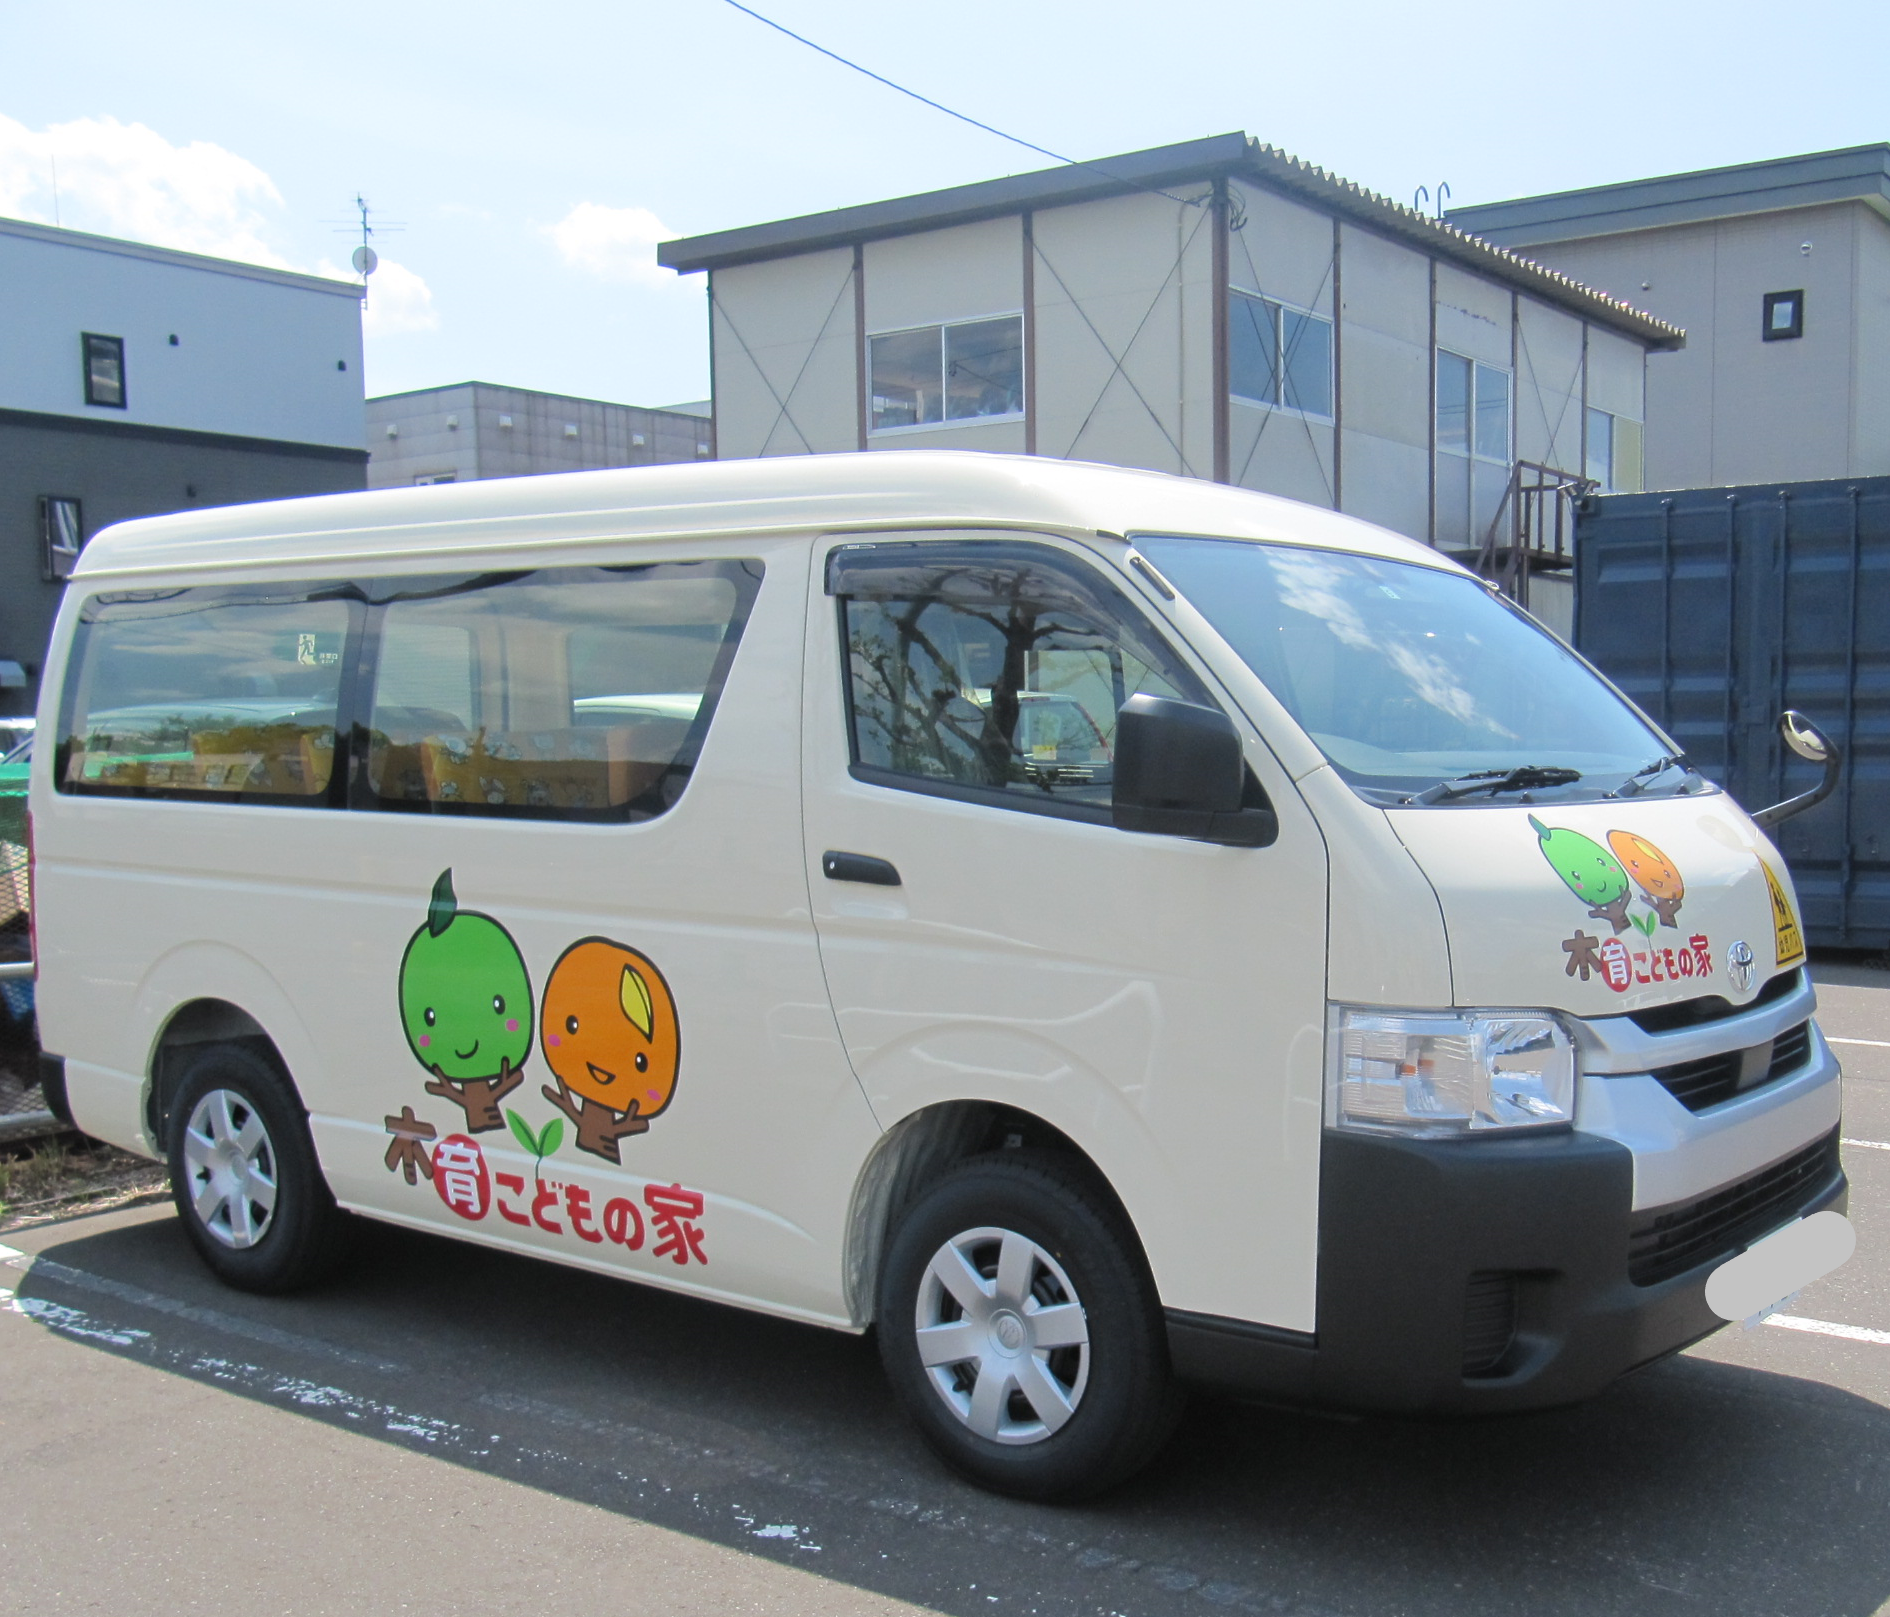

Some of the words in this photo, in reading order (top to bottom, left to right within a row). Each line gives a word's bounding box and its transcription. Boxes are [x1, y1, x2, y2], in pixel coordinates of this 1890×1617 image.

[1561, 929, 1714, 993] 木育こどもの家
[384, 1105, 708, 1266] 木育こどもの家
